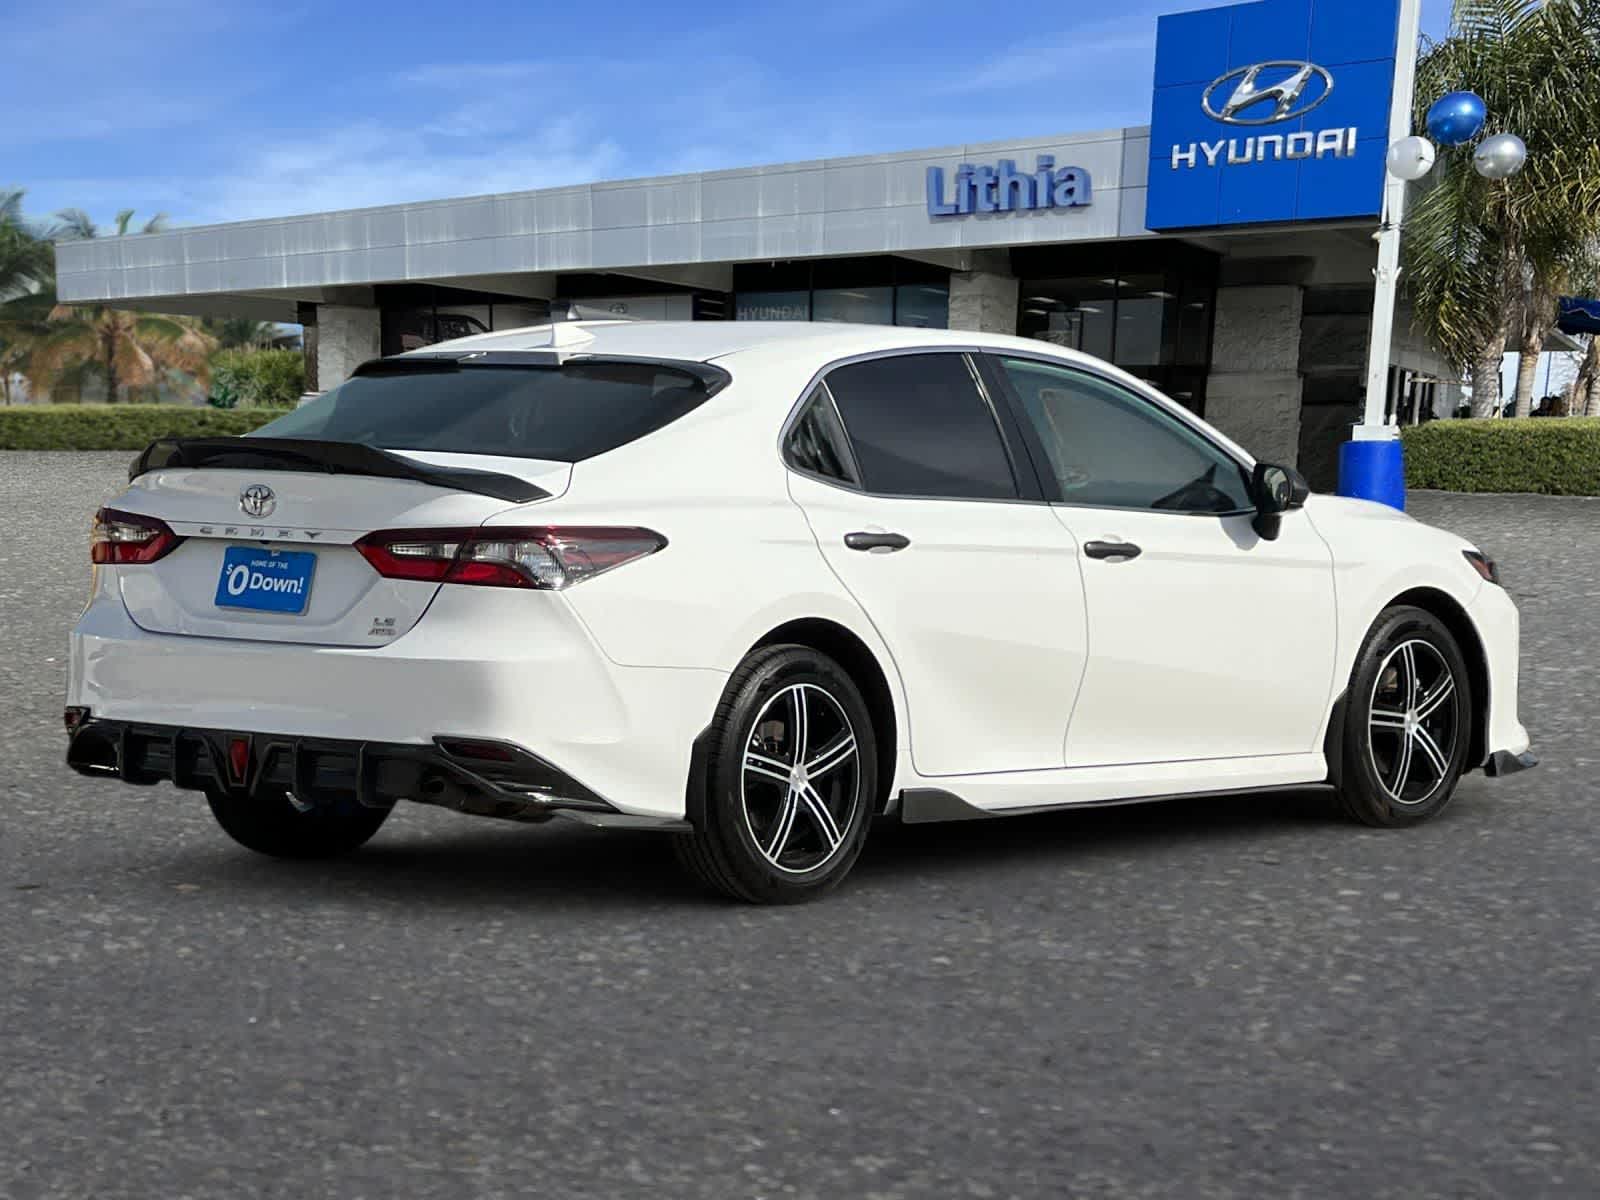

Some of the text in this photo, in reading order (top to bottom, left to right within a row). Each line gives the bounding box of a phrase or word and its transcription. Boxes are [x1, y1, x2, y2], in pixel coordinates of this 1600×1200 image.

[1170, 126, 1358, 170] HYUNDAI
[926, 154, 1093, 217] Lithia
[736, 304, 809, 321] HYUNDAI
[250, 559, 268, 568] HOME
[277, 561, 289, 570] THE
[249, 572, 304, 594] Down!
